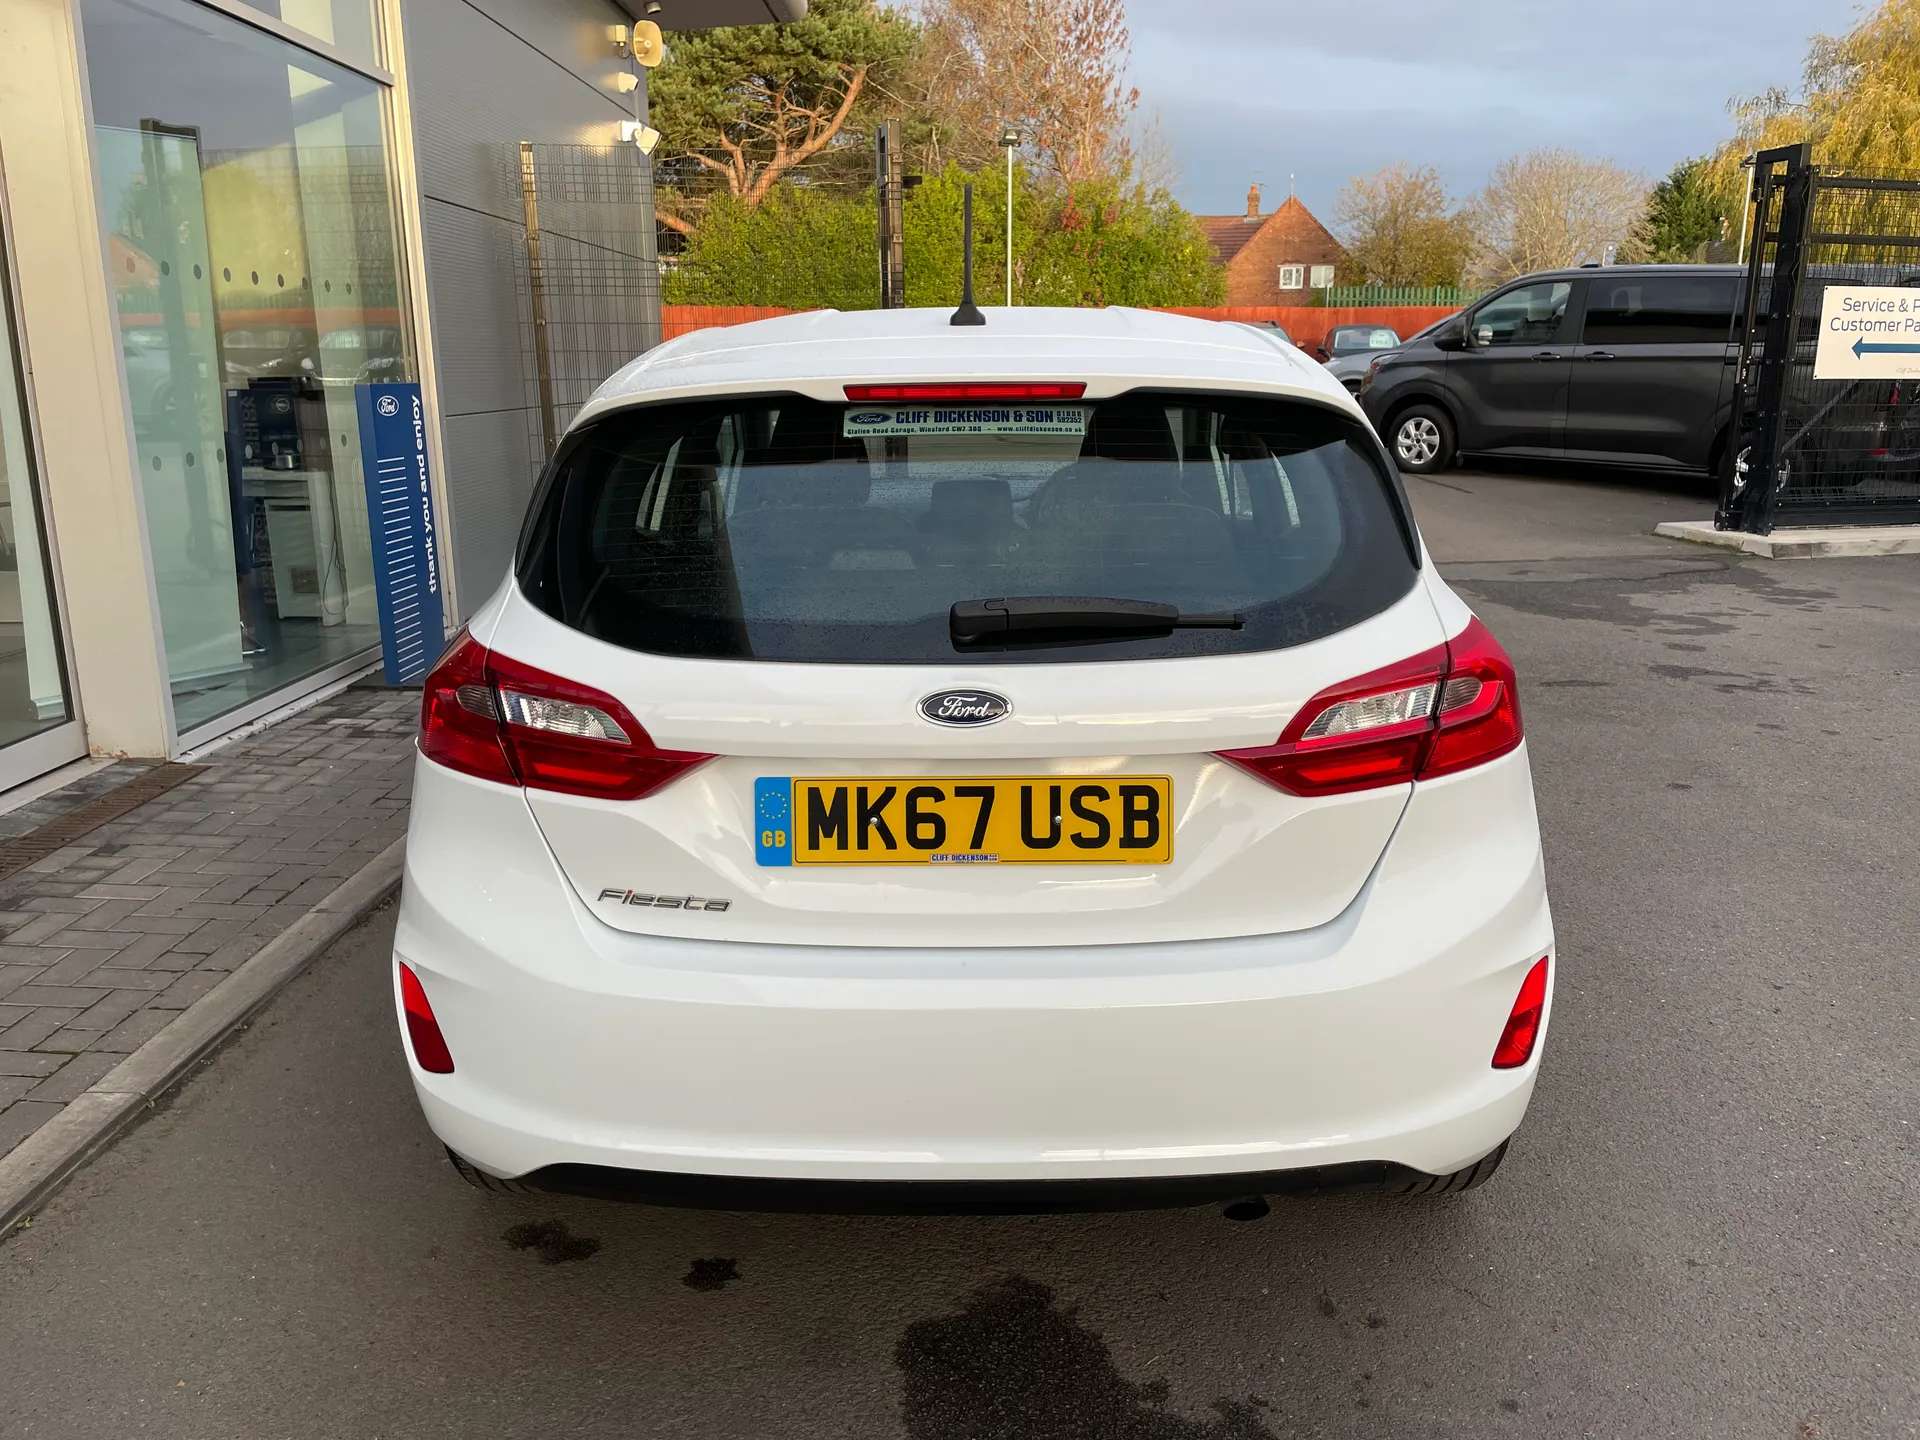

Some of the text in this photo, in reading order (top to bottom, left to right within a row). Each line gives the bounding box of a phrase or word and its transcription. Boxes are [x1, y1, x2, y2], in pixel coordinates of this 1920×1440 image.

[1842, 297, 1895, 312] Service
[1898, 298, 1908, 312] &
[1830, 317, 1901, 332] Customer
[895, 410, 1054, 423] CLIFF DICKENSON & SON
[411, 394, 437, 594] thank you and enjoy
[807, 785, 1160, 850] MK67 USB
[762, 830, 786, 848] GB
[597, 887, 732, 912] Fiesta
